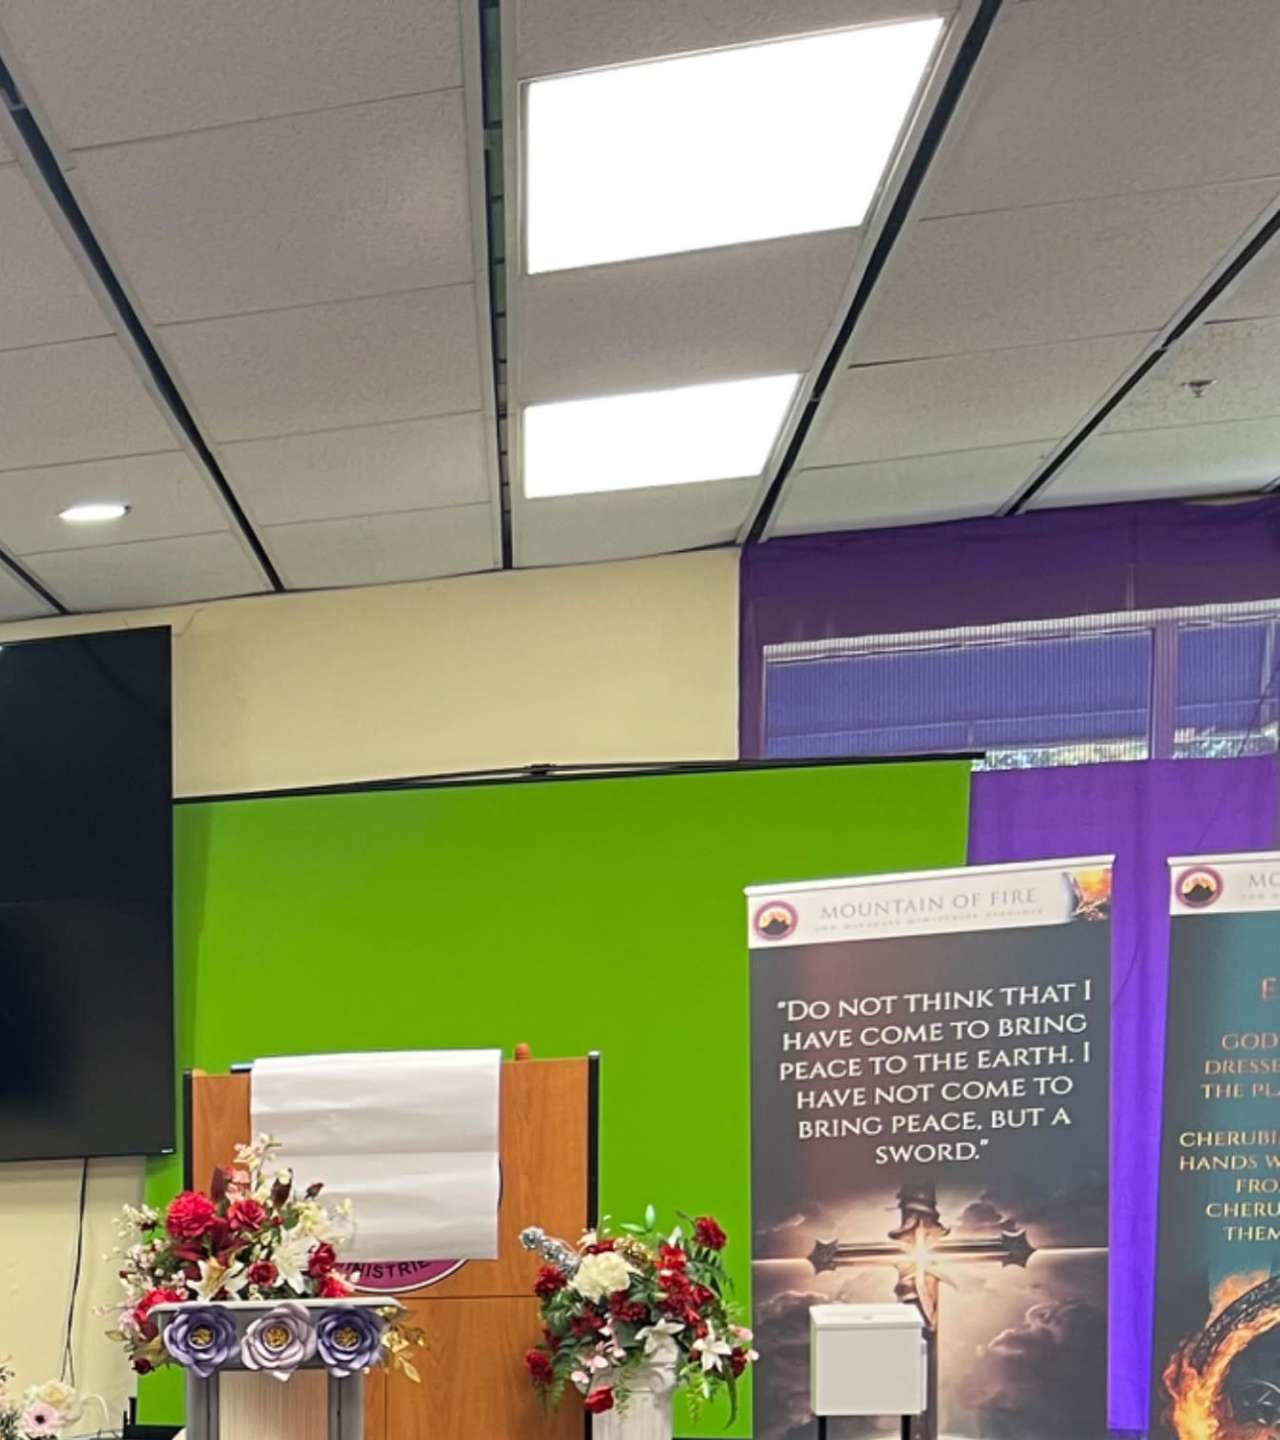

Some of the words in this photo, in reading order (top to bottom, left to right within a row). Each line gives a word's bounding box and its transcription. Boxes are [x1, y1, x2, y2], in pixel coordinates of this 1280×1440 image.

[820, 893, 944, 920] MOUNTAIN
[952, 891, 982, 910] OF
[990, 887, 1036, 905] FIRE
[777, 999, 830, 1022] "DO
[838, 995, 897, 1018] NOT
[903, 988, 994, 1013] THINK
[1000, 983, 1076, 1007] THAT
[1083, 979, 1091, 1001] I
[782, 1029, 853, 1051] HAVE
[860, 1022, 943, 1047] COME
[950, 1020, 990, 1040] TO
[997, 1013, 1087, 1038] BRING
[779, 1058, 863, 1081] PEACE
[869, 1055, 907, 1076] TO
[914, 1051, 969, 1073] THE
[977, 1045, 1075, 1069] EARTH.
[1082, 1041, 1091, 1063] I
[796, 1088, 867, 1110] HAVE
[874, 1083, 935, 1105] NOT
[941, 1077, 1026, 1101] COME
[1033, 1075, 1073, 1096] TO
[1201, 1082, 1244, 1099] THE
[798, 1117, 883, 1139] BRING
[991, 1107, 1044, 1129] BUT
[1050, 1107, 1072, 1126] A
[1179, 1154, 1258, 1172] HANDS
[1235, 1178, 1280, 1194] FRO
